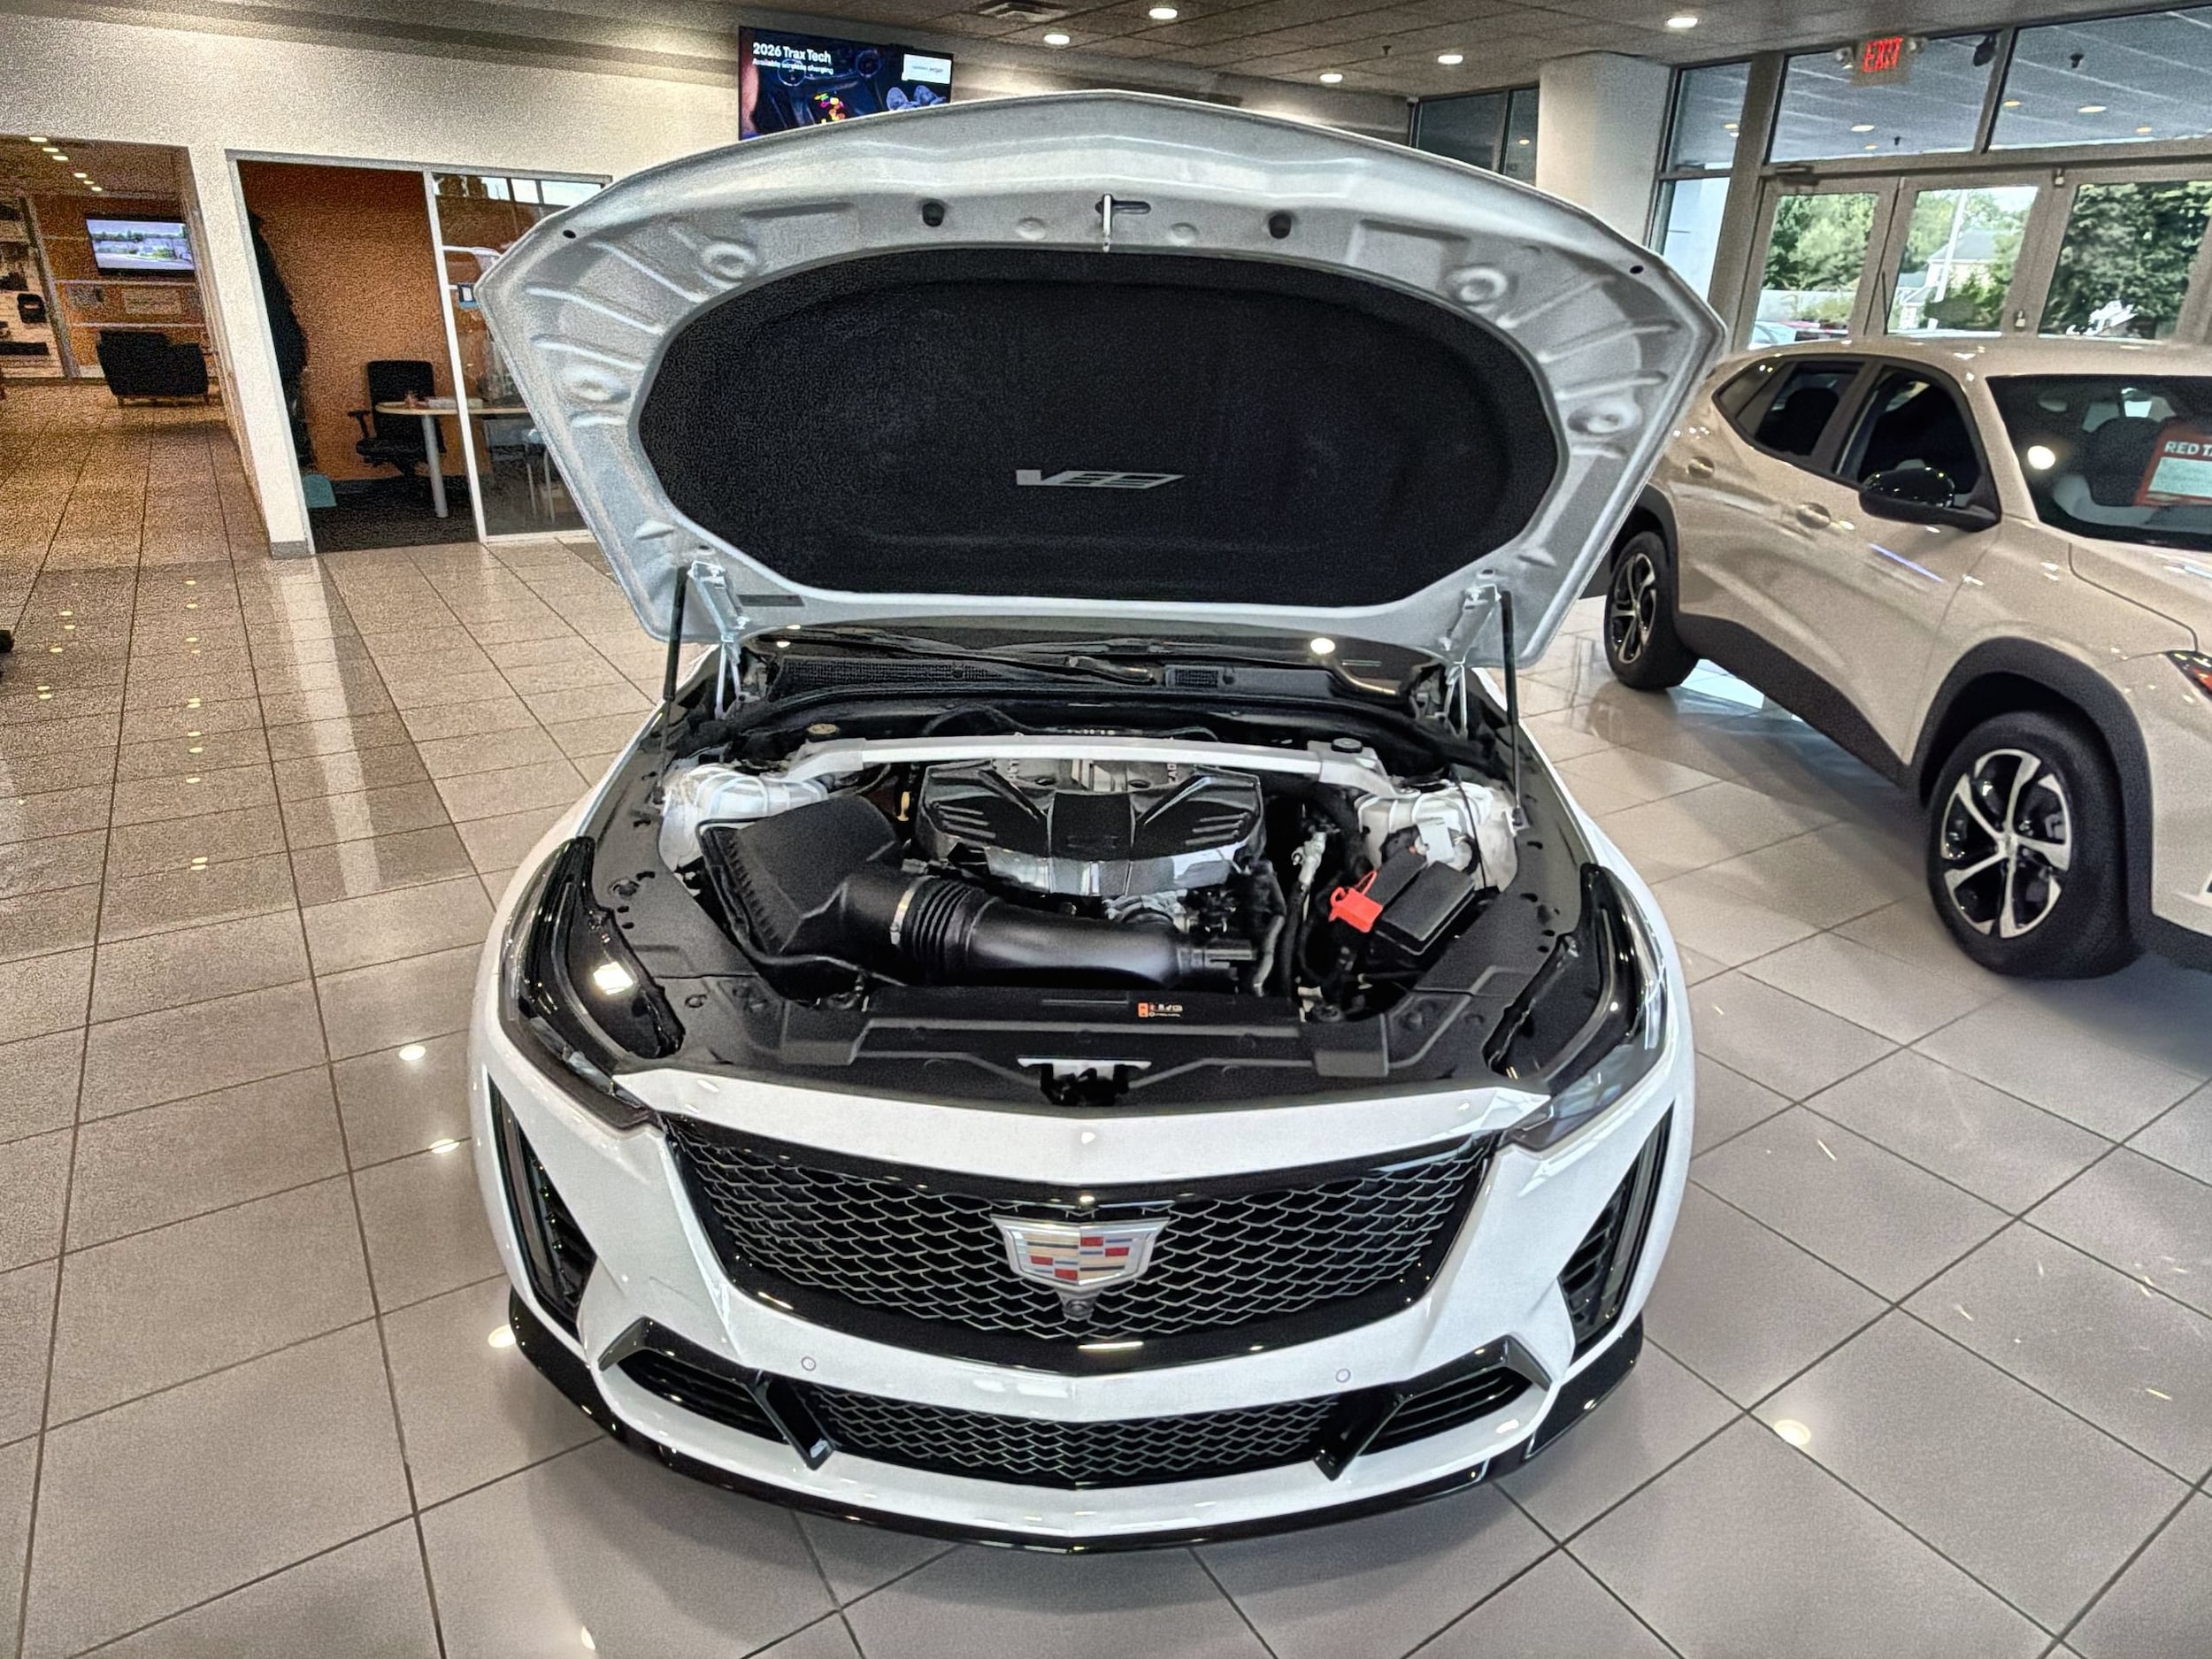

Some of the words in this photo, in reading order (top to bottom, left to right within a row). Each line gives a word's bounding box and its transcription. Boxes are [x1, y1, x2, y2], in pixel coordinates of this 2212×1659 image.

[752, 42, 782, 58] 2026
[782, 46, 806, 60] Trax
[806, 49, 832, 65] Tech
[1863, 36, 1904, 73] EXIT
[2164, 441, 2200, 455] RED
